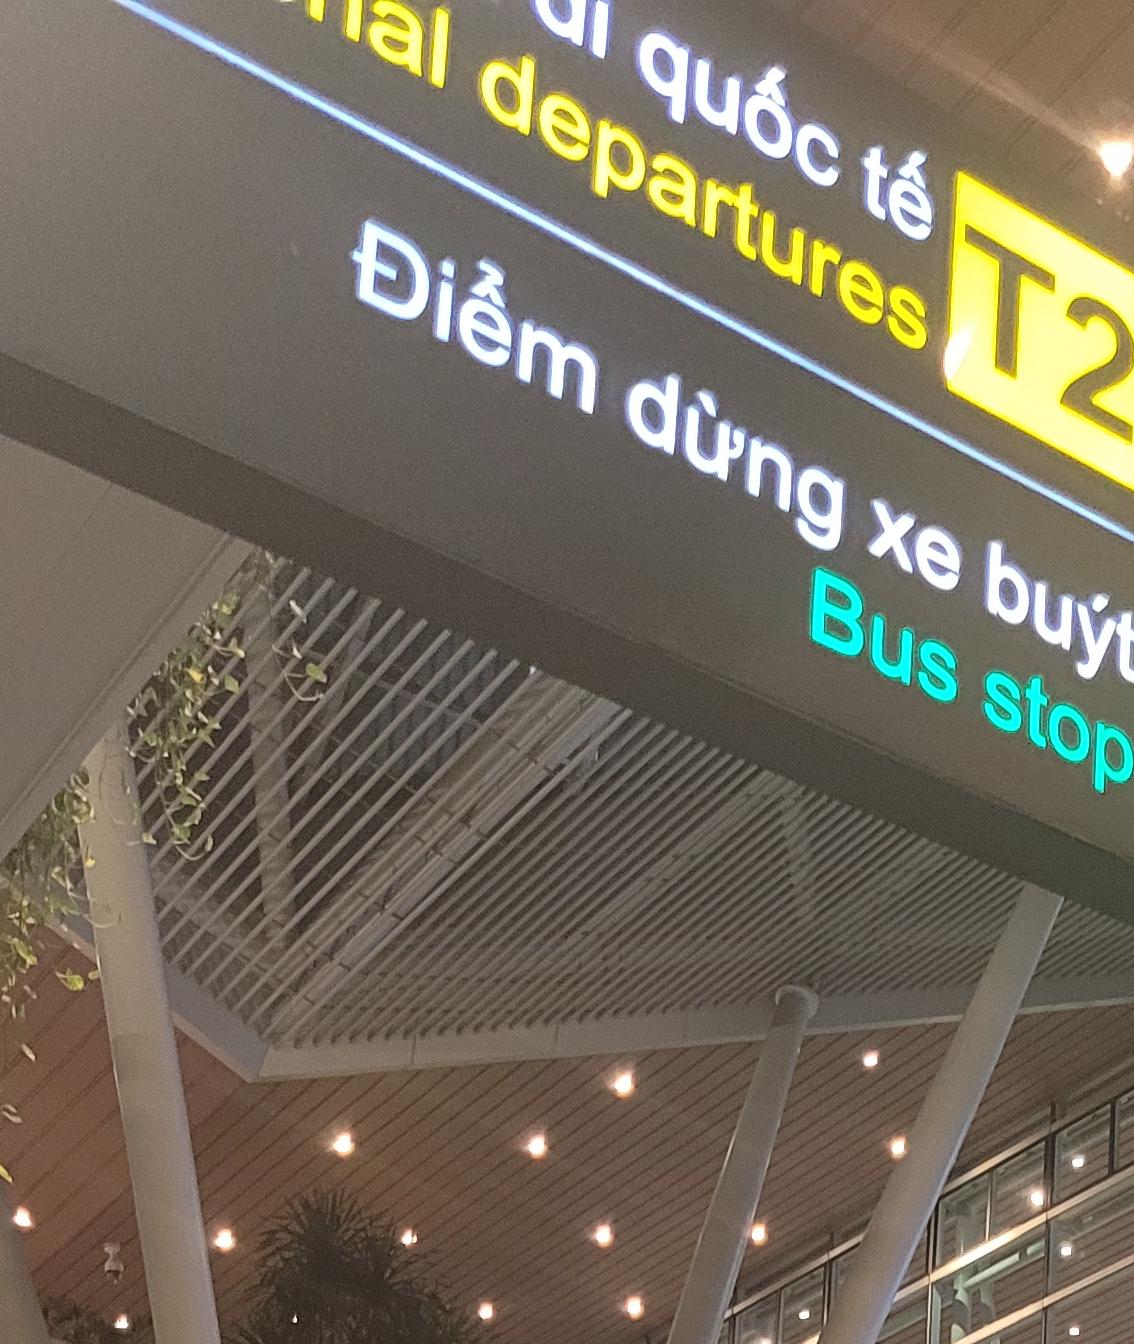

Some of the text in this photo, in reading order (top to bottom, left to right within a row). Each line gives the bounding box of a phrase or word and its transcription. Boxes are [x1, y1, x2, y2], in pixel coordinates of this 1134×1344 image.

[479, 54, 929, 350] departures
[636, 30, 842, 189] quốc
[861, 147, 934, 242] tế
[351, 218, 599, 415] Điểm
[626, 374, 845, 551] dừng
[869, 498, 962, 590] xe
[811, 567, 1134, 794] Bus stop
